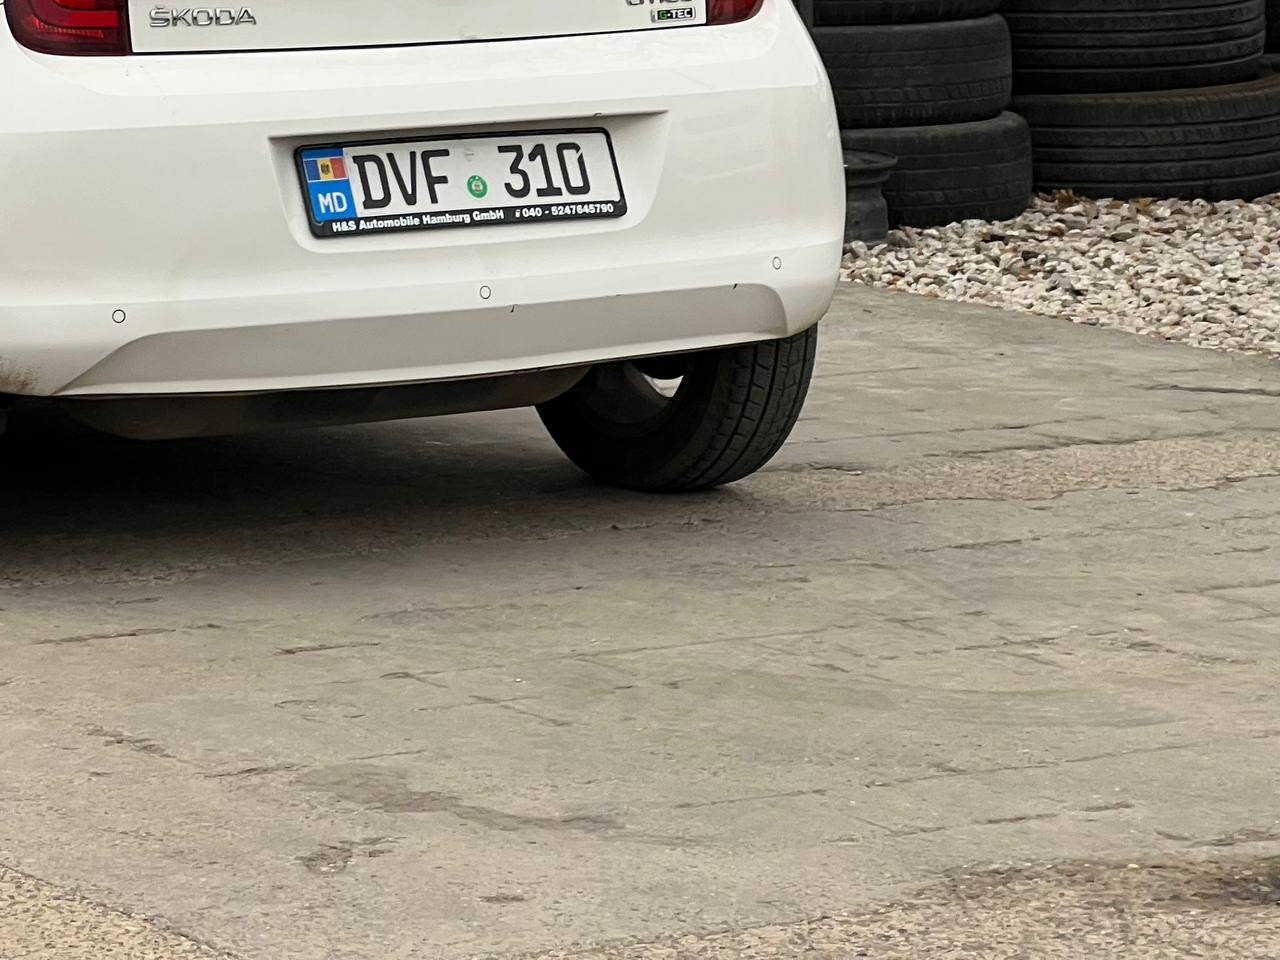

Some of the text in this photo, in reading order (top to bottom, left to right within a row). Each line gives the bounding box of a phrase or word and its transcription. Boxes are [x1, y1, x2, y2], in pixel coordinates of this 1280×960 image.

[149, 6, 257, 27] ŠKODA
[351, 142, 591, 210] DVF 310
[318, 192, 348, 215] MD
[332, 221, 357, 233] H&S
[359, 216, 420, 230] Automobile
[422, 212, 470, 225] Hamburg
[472, 209, 505, 221] GmbH
[522, 207, 543, 218] 040
[551, 203, 614, 216] 5247645790
